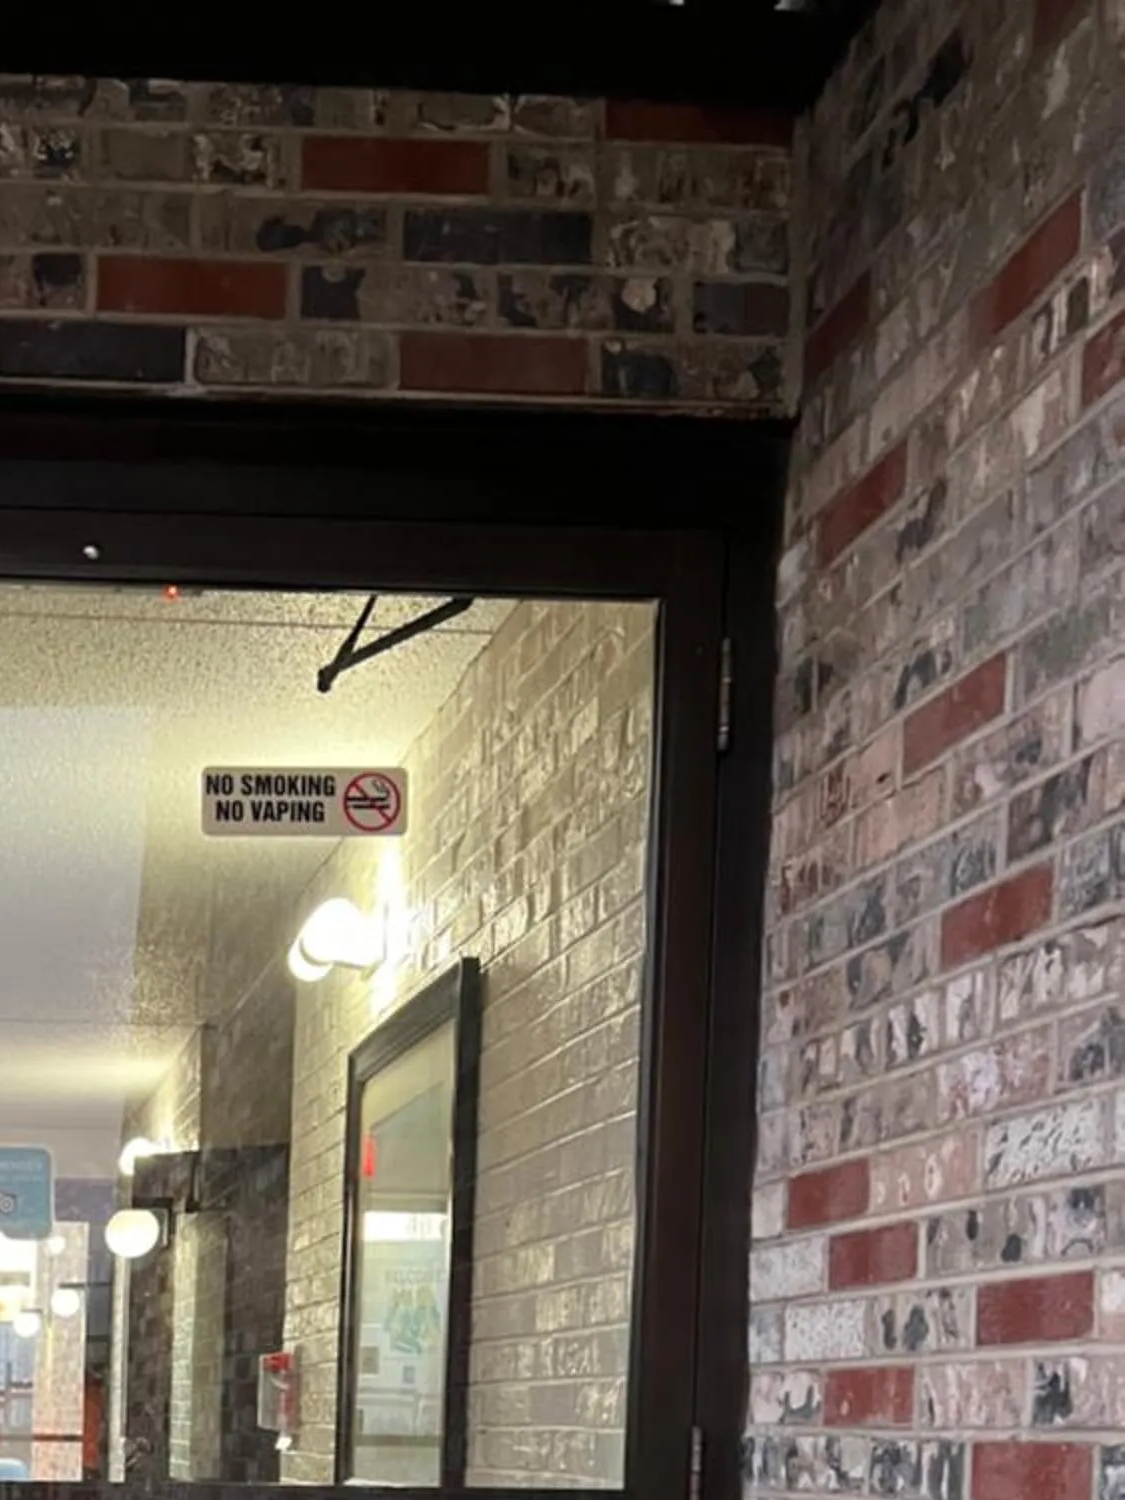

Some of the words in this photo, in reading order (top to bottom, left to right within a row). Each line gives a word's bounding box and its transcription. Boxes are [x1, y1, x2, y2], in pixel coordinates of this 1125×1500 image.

[206, 775, 234, 796] NO
[241, 775, 336, 797] SMOKING
[215, 801, 244, 822] NO
[251, 801, 325, 823] VAPING
